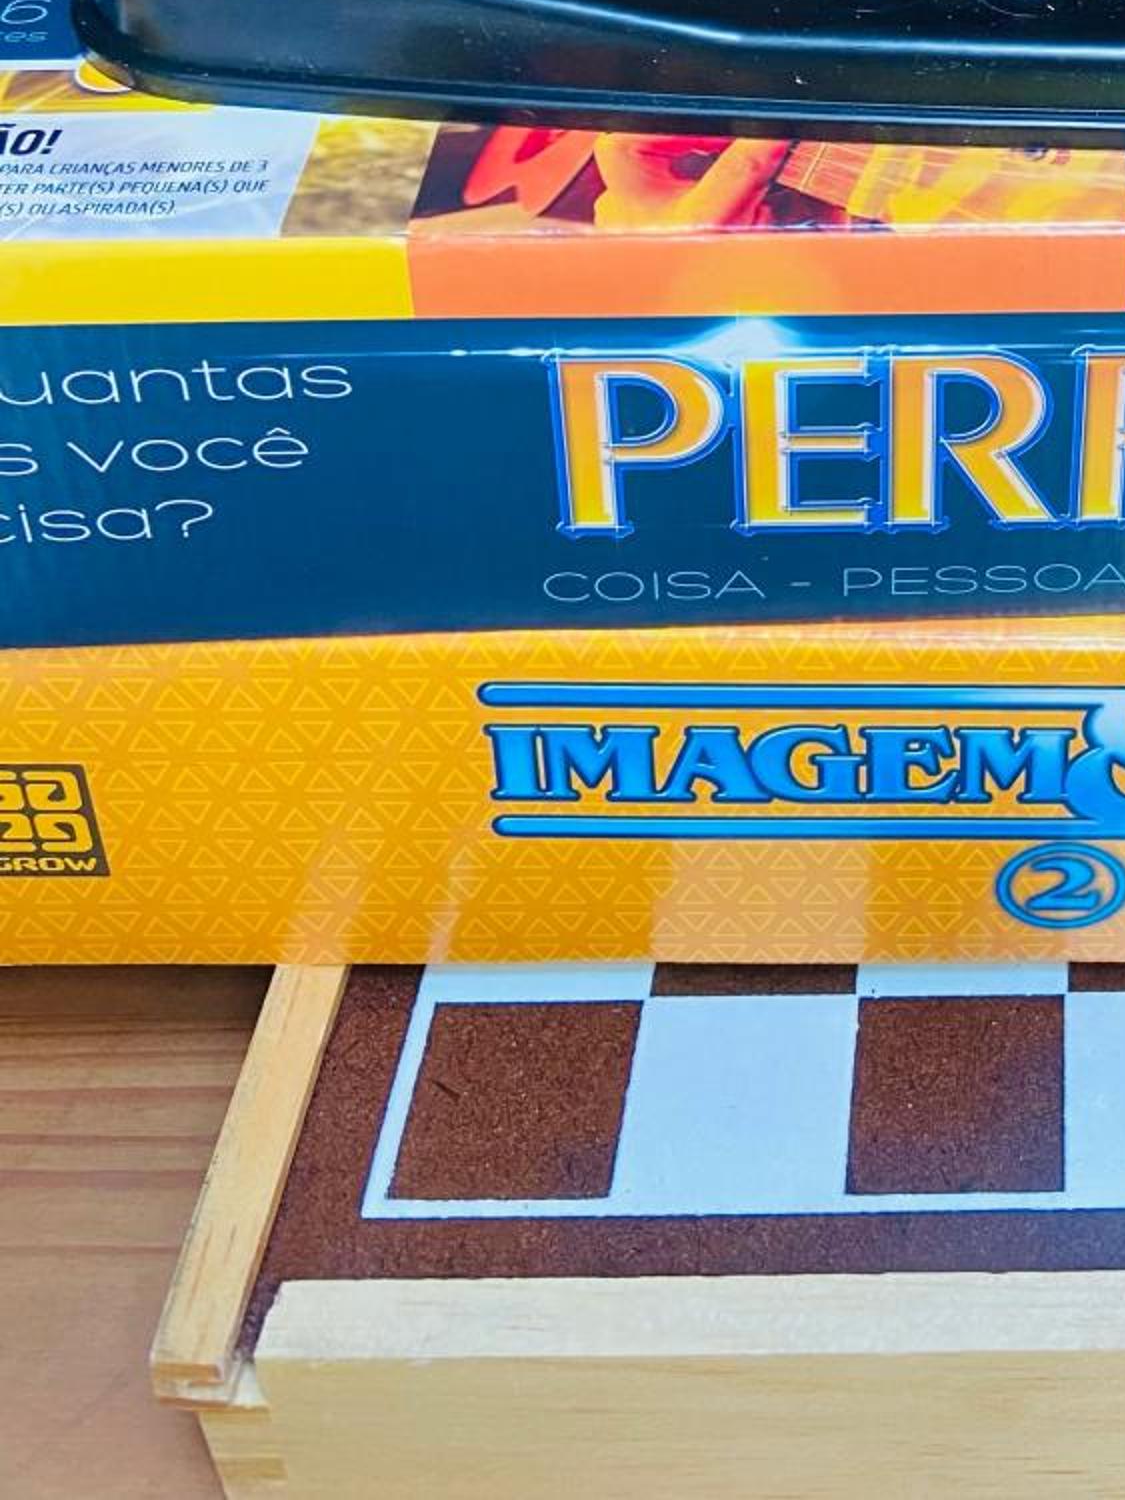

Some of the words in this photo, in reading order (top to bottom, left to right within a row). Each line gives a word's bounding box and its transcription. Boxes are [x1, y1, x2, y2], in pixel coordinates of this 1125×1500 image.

[0, 31, 49, 43] es
[49, 161, 136, 176] CRIANÇAS
[140, 160, 225, 173] MENORES
[230, 160, 253, 173] DE
[0, 359, 352, 406] uantas
[0, 443, 39, 476] s
[67, 428, 309, 472] você
[543, 568, 766, 601] COISA
[484, 722, 1077, 805] IMAGEM
[0, 856, 98, 872] GROW
